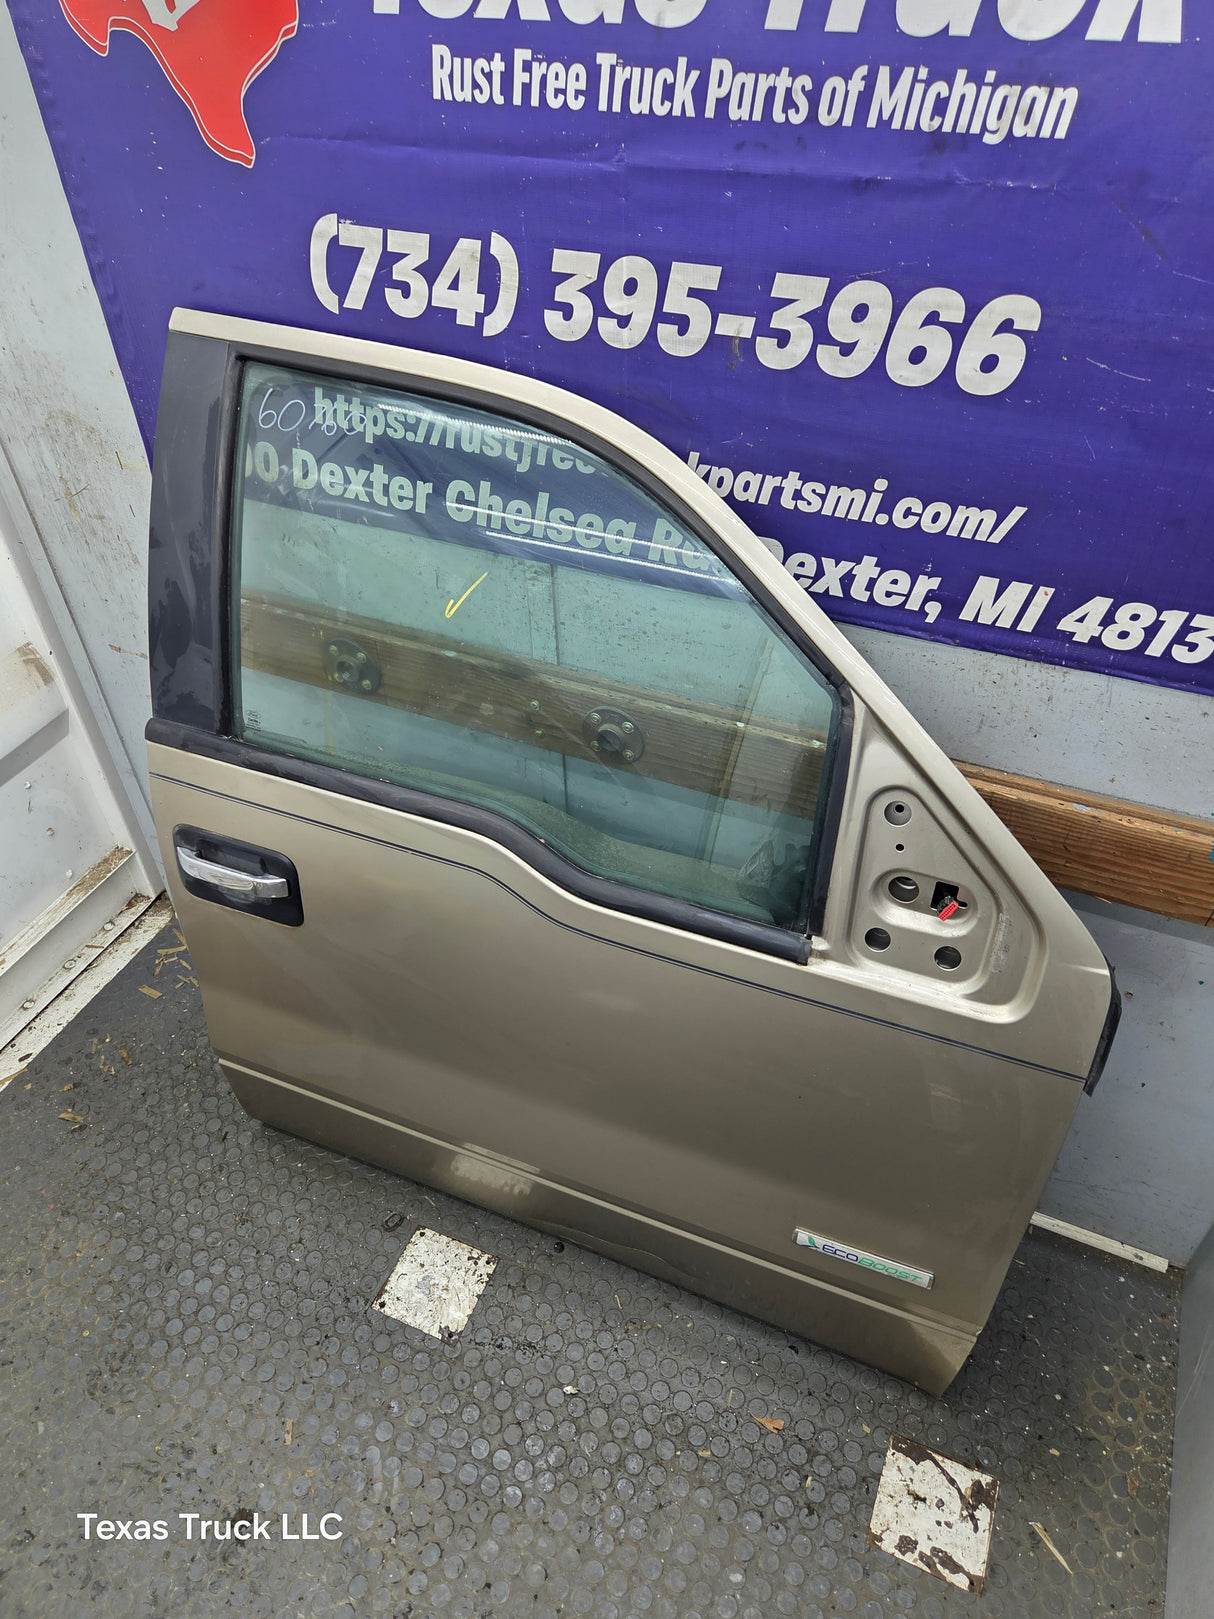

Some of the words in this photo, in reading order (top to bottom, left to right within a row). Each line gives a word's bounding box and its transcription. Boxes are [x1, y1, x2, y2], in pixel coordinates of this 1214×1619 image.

[431, 43, 506, 106] Rust
[512, 47, 588, 111] Free
[596, 52, 701, 118] Truck
[704, 57, 814, 126] Parts
[817, 64, 869, 127] of
[866, 64, 1079, 145] Michigan
[309, 212, 520, 338] (734)
[543, 249, 1042, 396] 395-3966
[292, 447, 433, 514] Dexter
[445, 479, 637, 555] Chelsea
[959, 575, 1055, 633] MI
[1057, 596, 1214, 664] 4813
